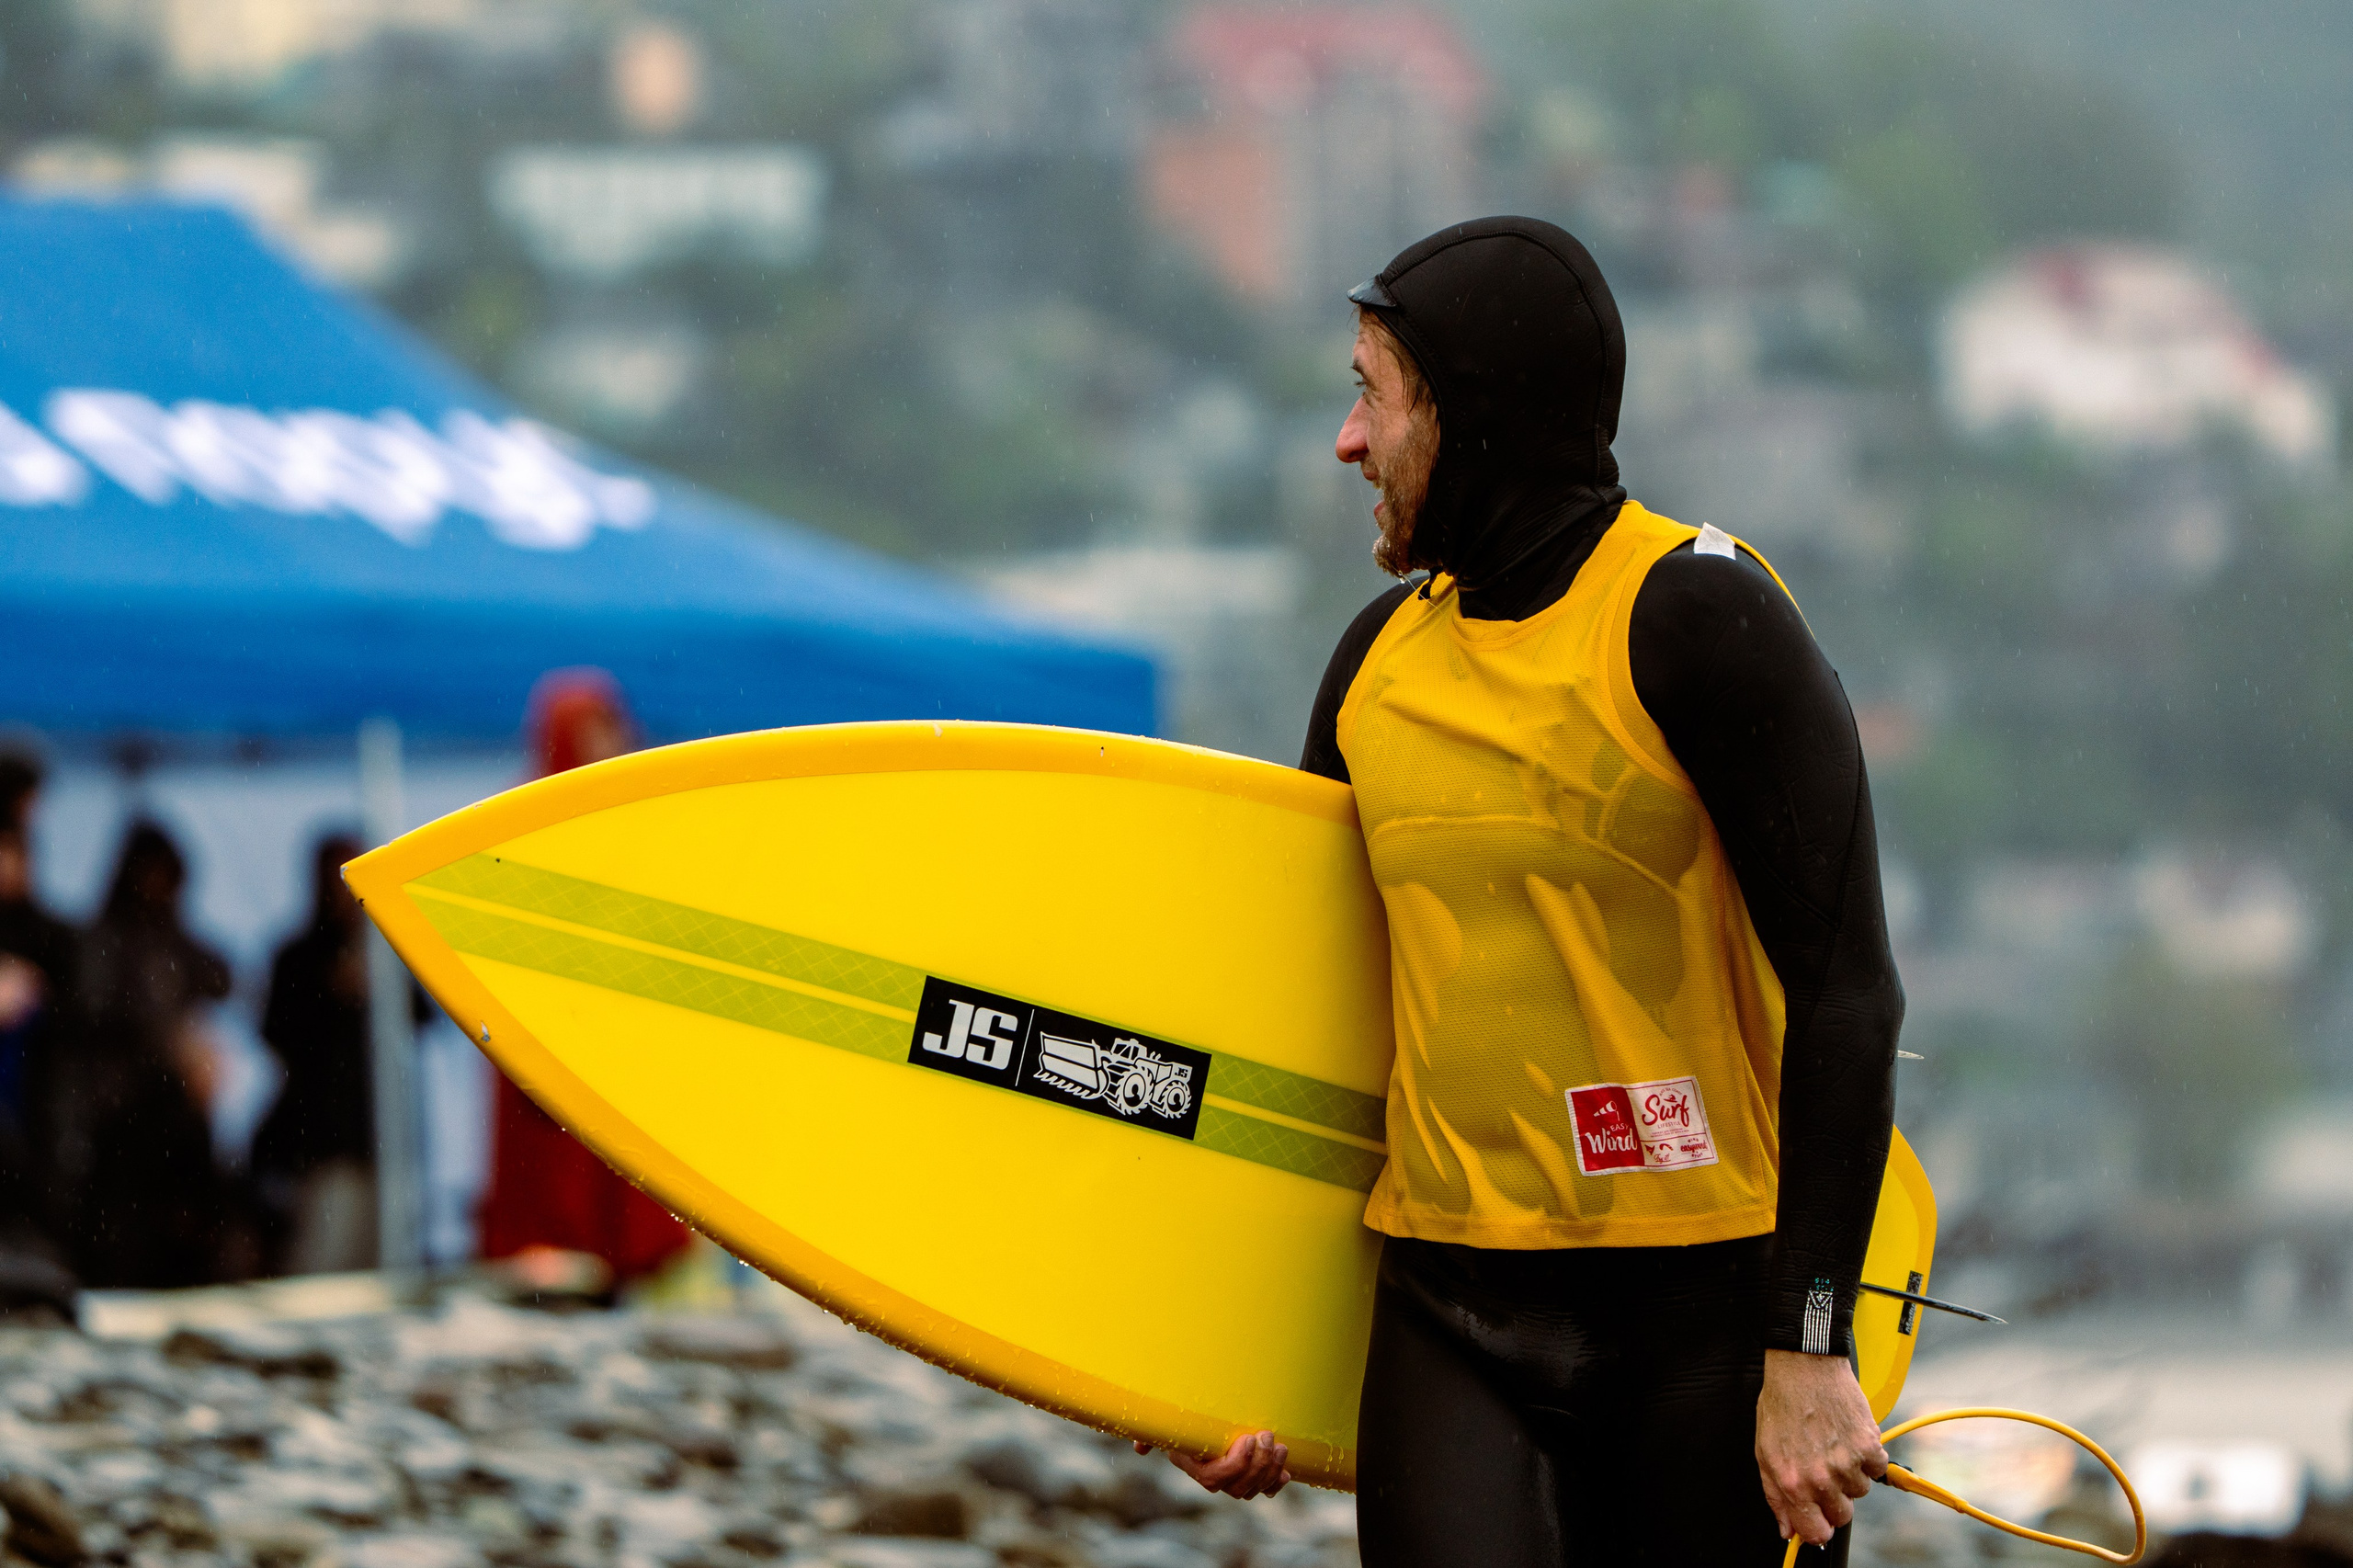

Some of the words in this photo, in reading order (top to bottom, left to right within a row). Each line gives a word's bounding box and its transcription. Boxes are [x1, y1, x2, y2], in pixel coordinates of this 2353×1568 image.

[923, 999, 1018, 1071] JS
[1174, 1066, 1188, 1078] JS
[1642, 1094, 1689, 1127] Surf
[1610, 1123, 1630, 1132] EASY
[1585, 1128, 1637, 1153] Wind
